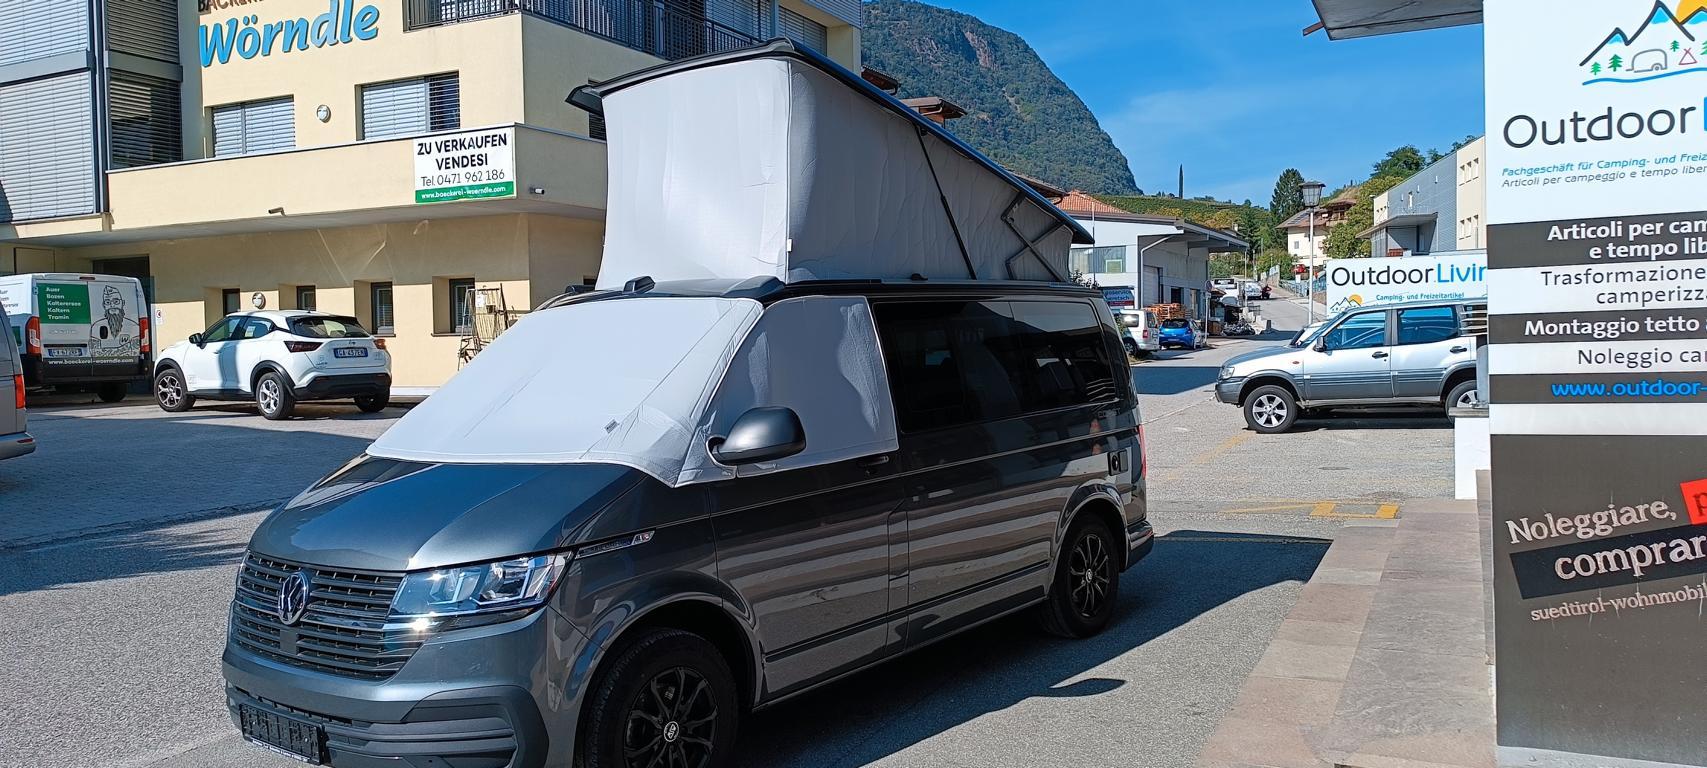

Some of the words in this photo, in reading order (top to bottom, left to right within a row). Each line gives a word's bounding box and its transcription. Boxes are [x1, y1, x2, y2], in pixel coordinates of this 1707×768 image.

[198, 0, 380, 67] Wörndle
[1503, 106, 1697, 148] Outdoor
[417, 142, 432, 156] ZU
[435, 133, 507, 153] VERKAUFEN
[435, 153, 488, 170] VENDESI
[1502, 163, 1574, 176] Fachgeschäft
[1578, 161, 1593, 170] für
[1597, 158, 1650, 169] Camping-
[1654, 155, 1677, 164] und
[420, 175, 436, 187] Tel.
[437, 173, 461, 186] 0471
[464, 171, 483, 183] 962
[485, 169, 505, 181] 186
[1502, 177, 1540, 187] Articoli
[1543, 176, 1562, 187] per
[1565, 171, 1626, 183] campeggio
[1641, 168, 1678, 178] tempo
[1547, 221, 1623, 241] Articoli
[1629, 222, 1664, 241] per
[1589, 247, 1602, 259] e
[1606, 243, 1678, 261] tempo
[1331, 265, 1434, 287] Outdoor
[1541, 265, 1707, 286] Trasformazione
[1596, 286, 1707, 307] camperizz
[1524, 317, 1640, 339] Montaggio
[1644, 316, 1700, 333] tetto
[1578, 348, 1673, 369] Noleggio
[1505, 499, 1678, 545] Noleggiare,
[1554, 535, 1707, 580] comprar
